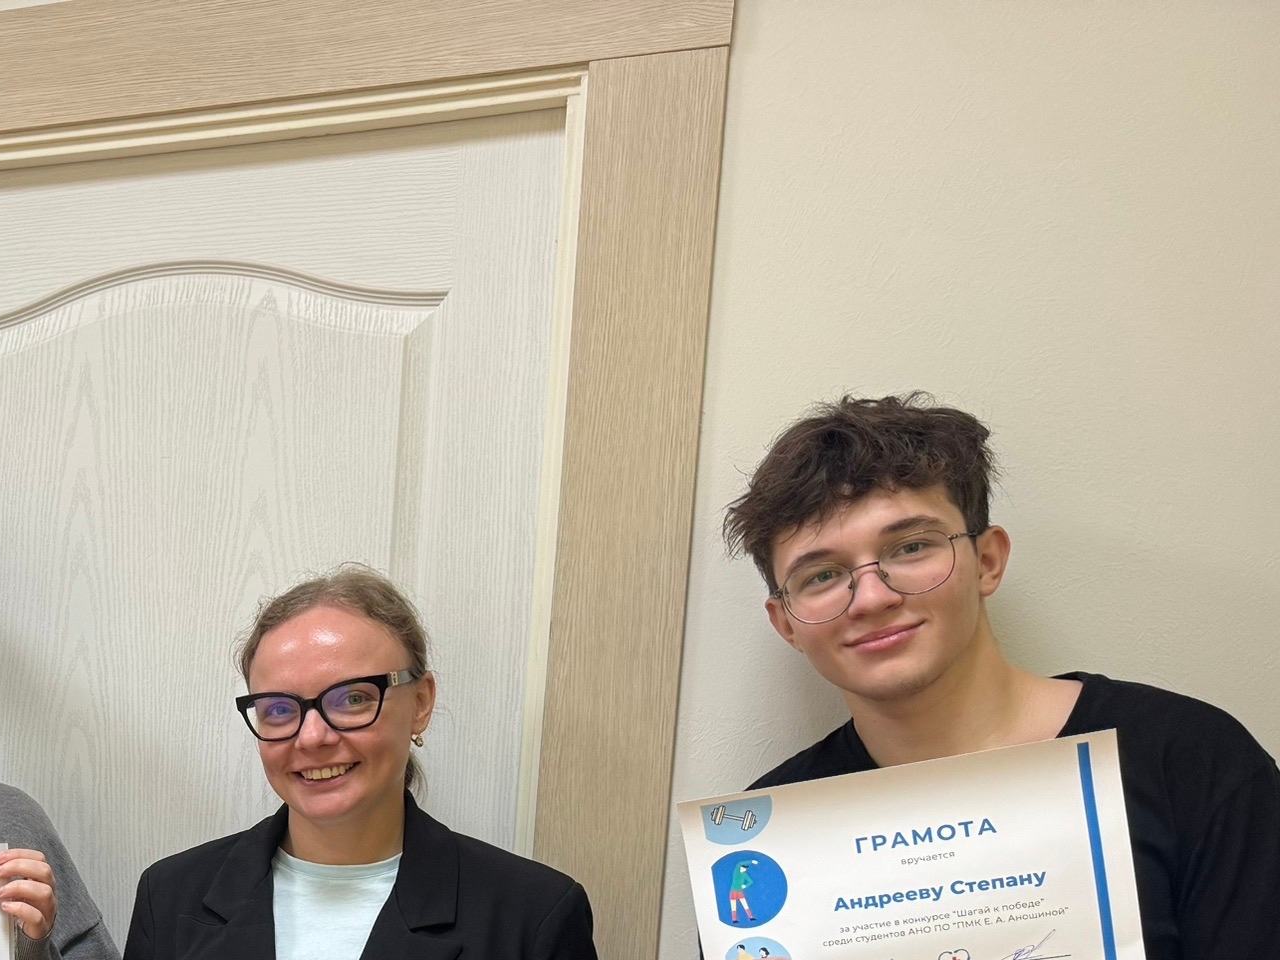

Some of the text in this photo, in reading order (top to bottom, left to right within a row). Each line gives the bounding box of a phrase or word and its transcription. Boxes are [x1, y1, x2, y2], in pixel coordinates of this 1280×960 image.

[855, 818, 997, 853] ГРАМОТА
[901, 852, 955, 865] вручается
[834, 872, 1046, 911] Андрееву Степану
[823, 907, 1068, 946] среди студентов АНО ПО "ПМК Е. А. Аношиной"
[840, 926, 850, 934] за
[852, 921, 891, 933] участие
[893, 919, 901, 927] в
[903, 913, 950, 924] конкурсе
[952, 906, 990, 917] "Шагай
[1002, 898, 1044, 911] победе"
